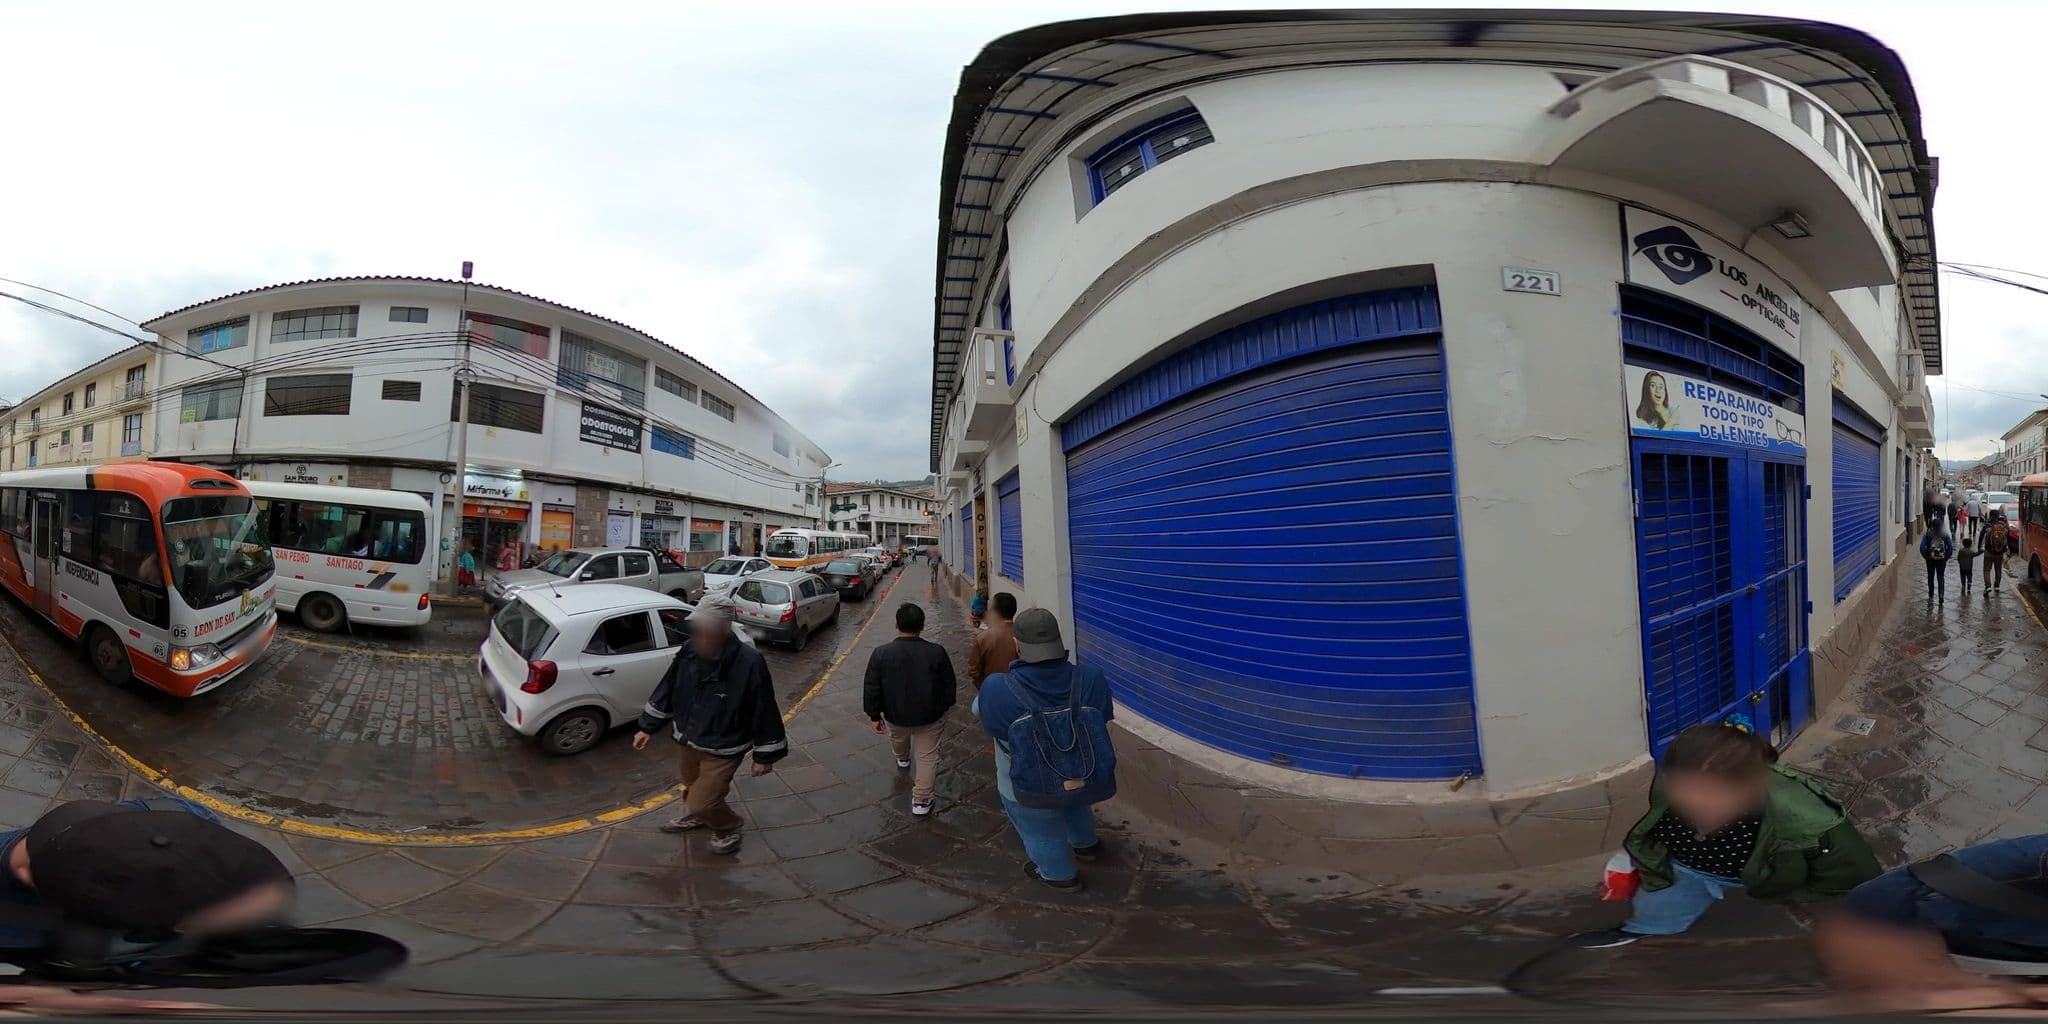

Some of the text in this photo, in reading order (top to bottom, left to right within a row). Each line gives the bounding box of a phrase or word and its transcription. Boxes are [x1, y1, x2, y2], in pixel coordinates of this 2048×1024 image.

[1511, 274, 1554, 291] 221
[1718, 258, 1800, 325] LOS ANGELES
[1741, 293, 1786, 330] OPTICAS
[1684, 380, 1774, 418] REPARAMOS
[581, 416, 634, 437] ODONTOLOGIA
[1702, 404, 1765, 429] TODO TIPO
[1700, 424, 1769, 447] DE LENTES
[466, 484, 501, 495] Mifarma
[976, 513, 987, 580] OPTICA
[275, 549, 364, 570] SAN PEDRO SANTIAGO
[173, 627, 187, 638] 05
[153, 644, 165, 656] 05
